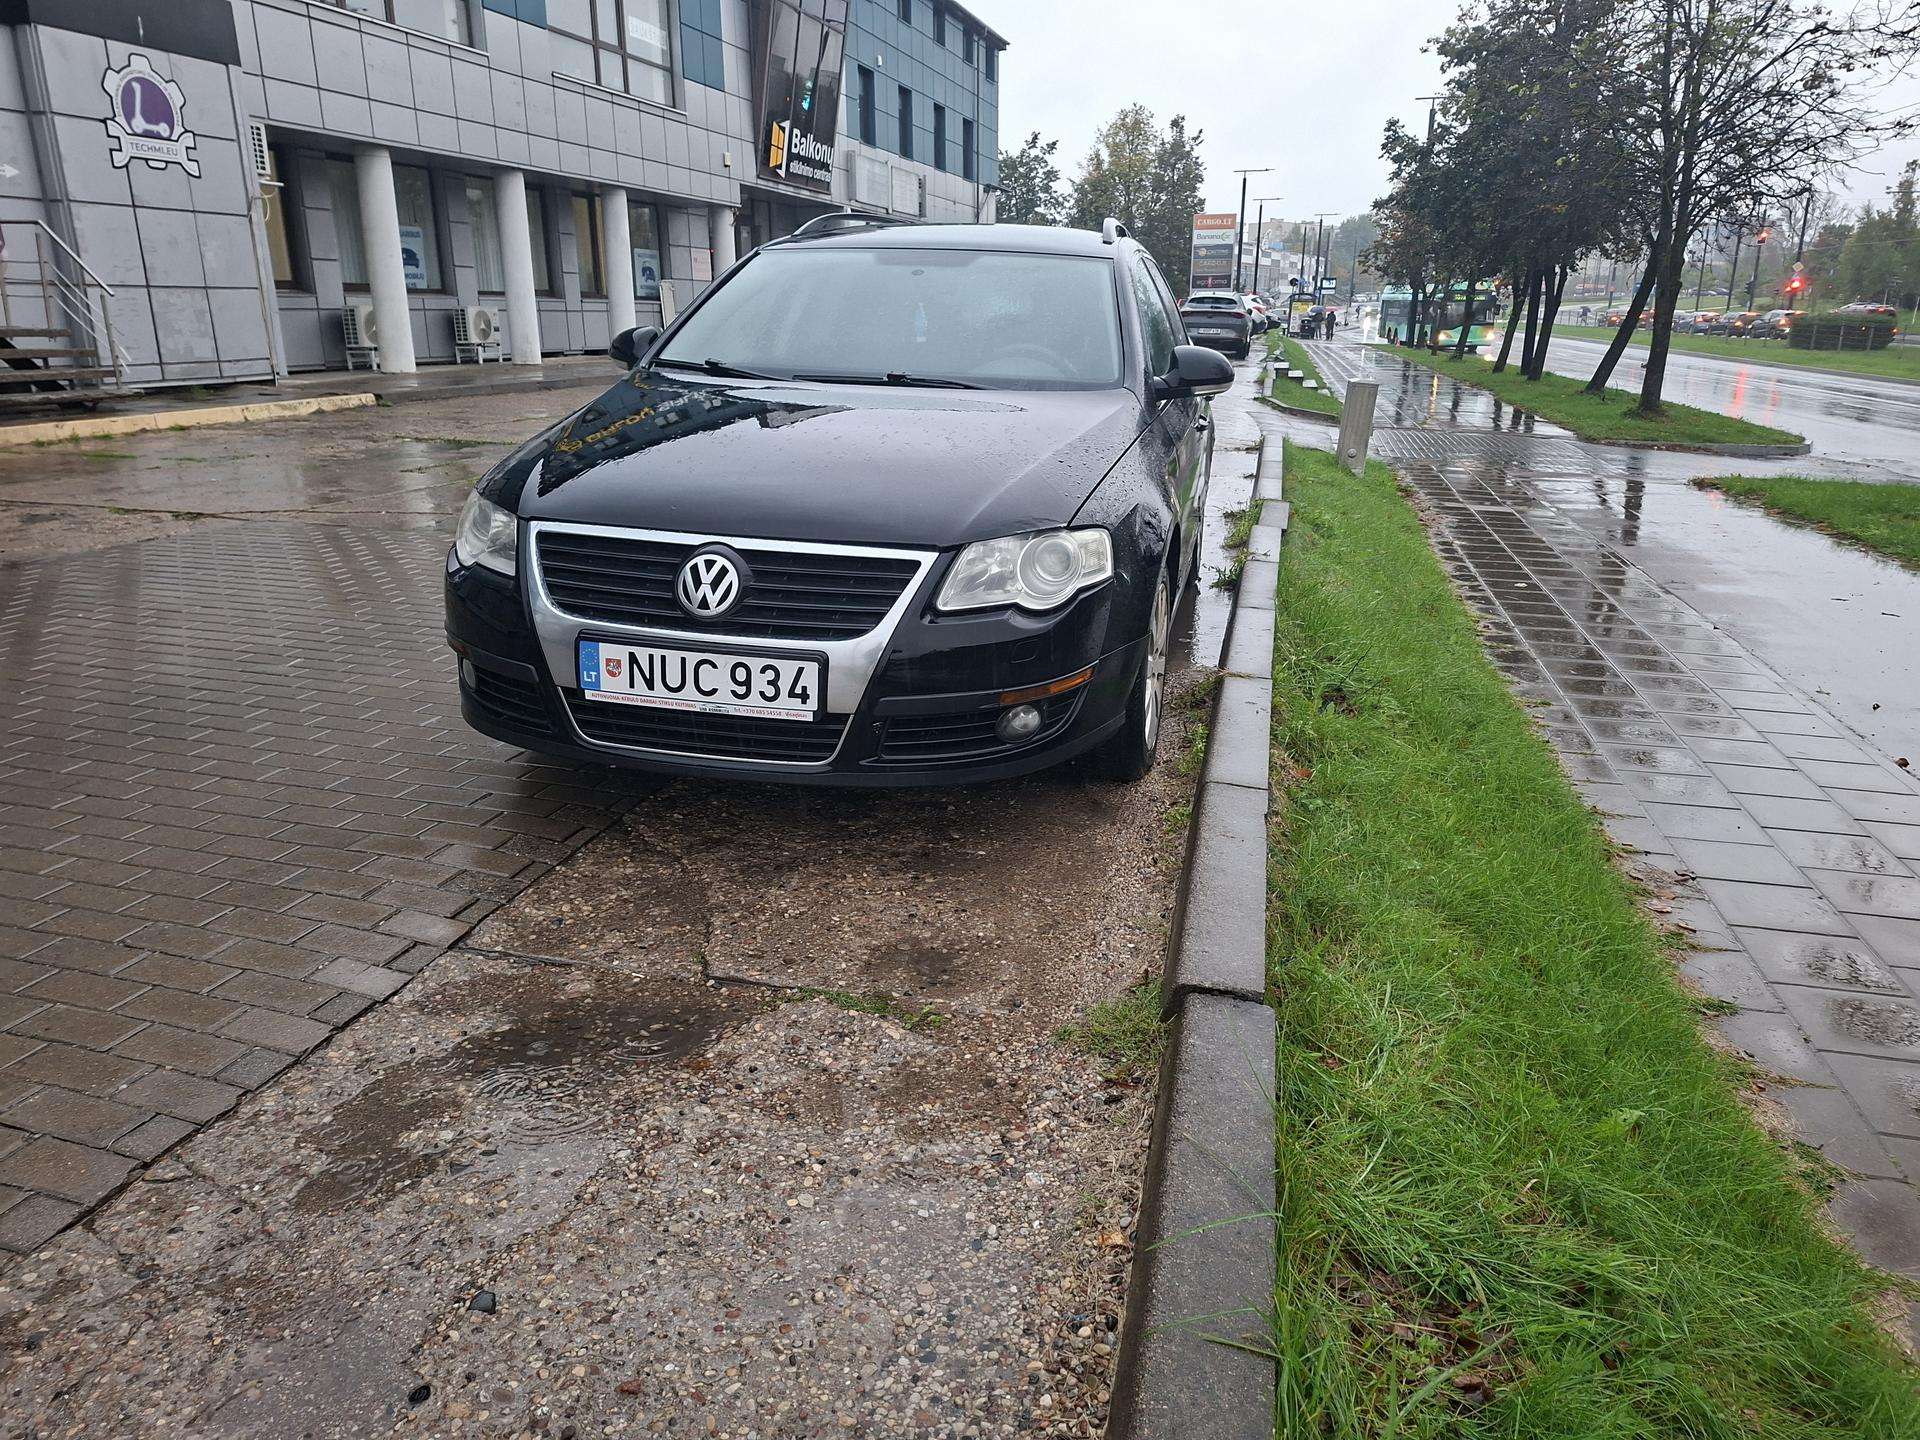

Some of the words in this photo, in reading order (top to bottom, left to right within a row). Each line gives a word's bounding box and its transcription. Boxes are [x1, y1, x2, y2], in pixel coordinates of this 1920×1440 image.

[583, 671, 597, 683] LT
[627, 651, 719, 698] NUC
[729, 661, 810, 705] 934
